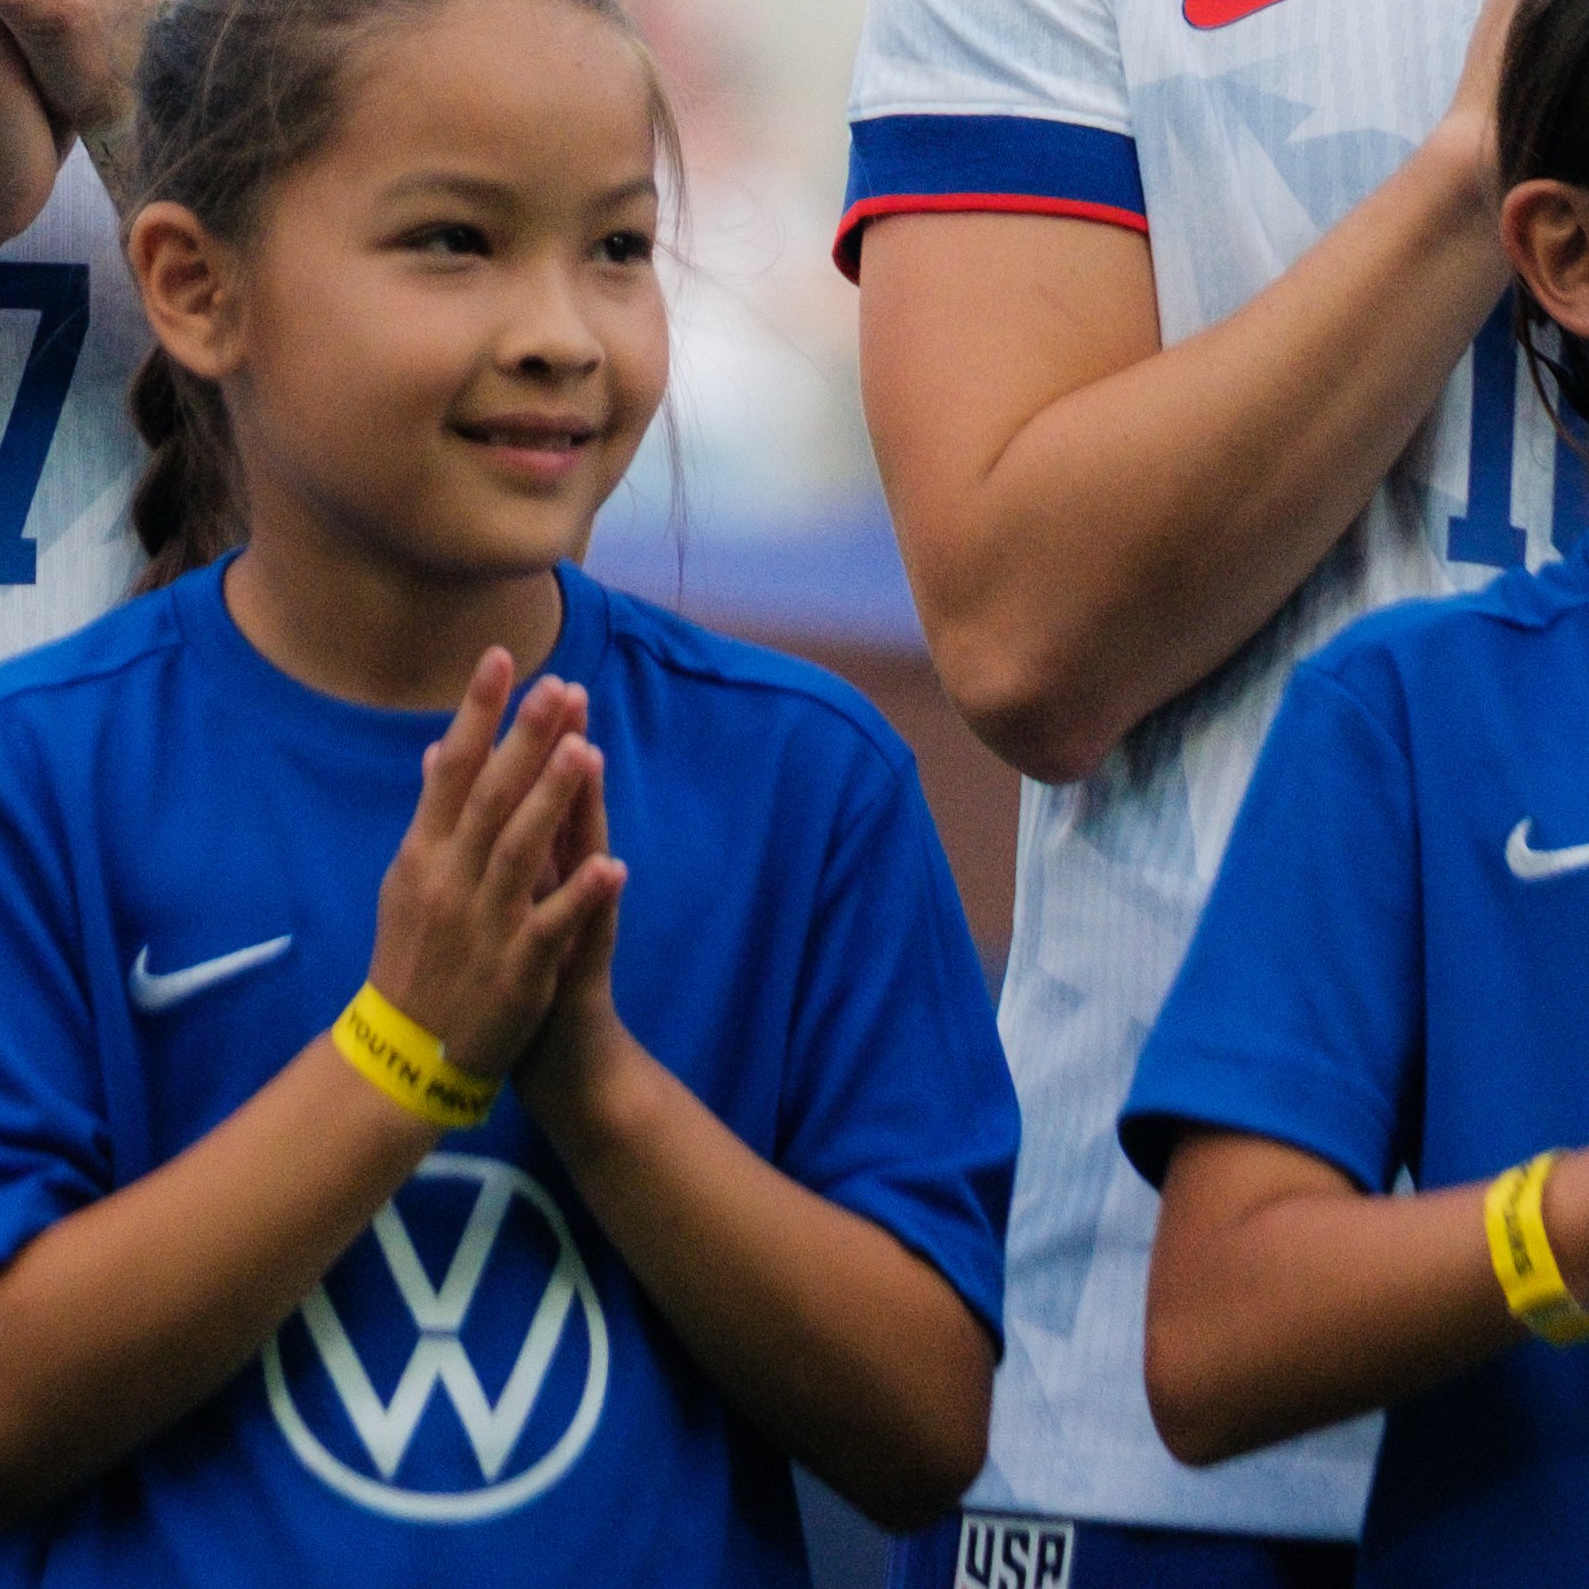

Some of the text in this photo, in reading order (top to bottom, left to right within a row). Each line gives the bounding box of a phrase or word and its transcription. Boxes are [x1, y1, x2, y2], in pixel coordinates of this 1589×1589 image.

[1446, 282, 1589, 572] 1
[299, 1172, 578, 1484] VW
[964, 1525, 1067, 1589] USA
